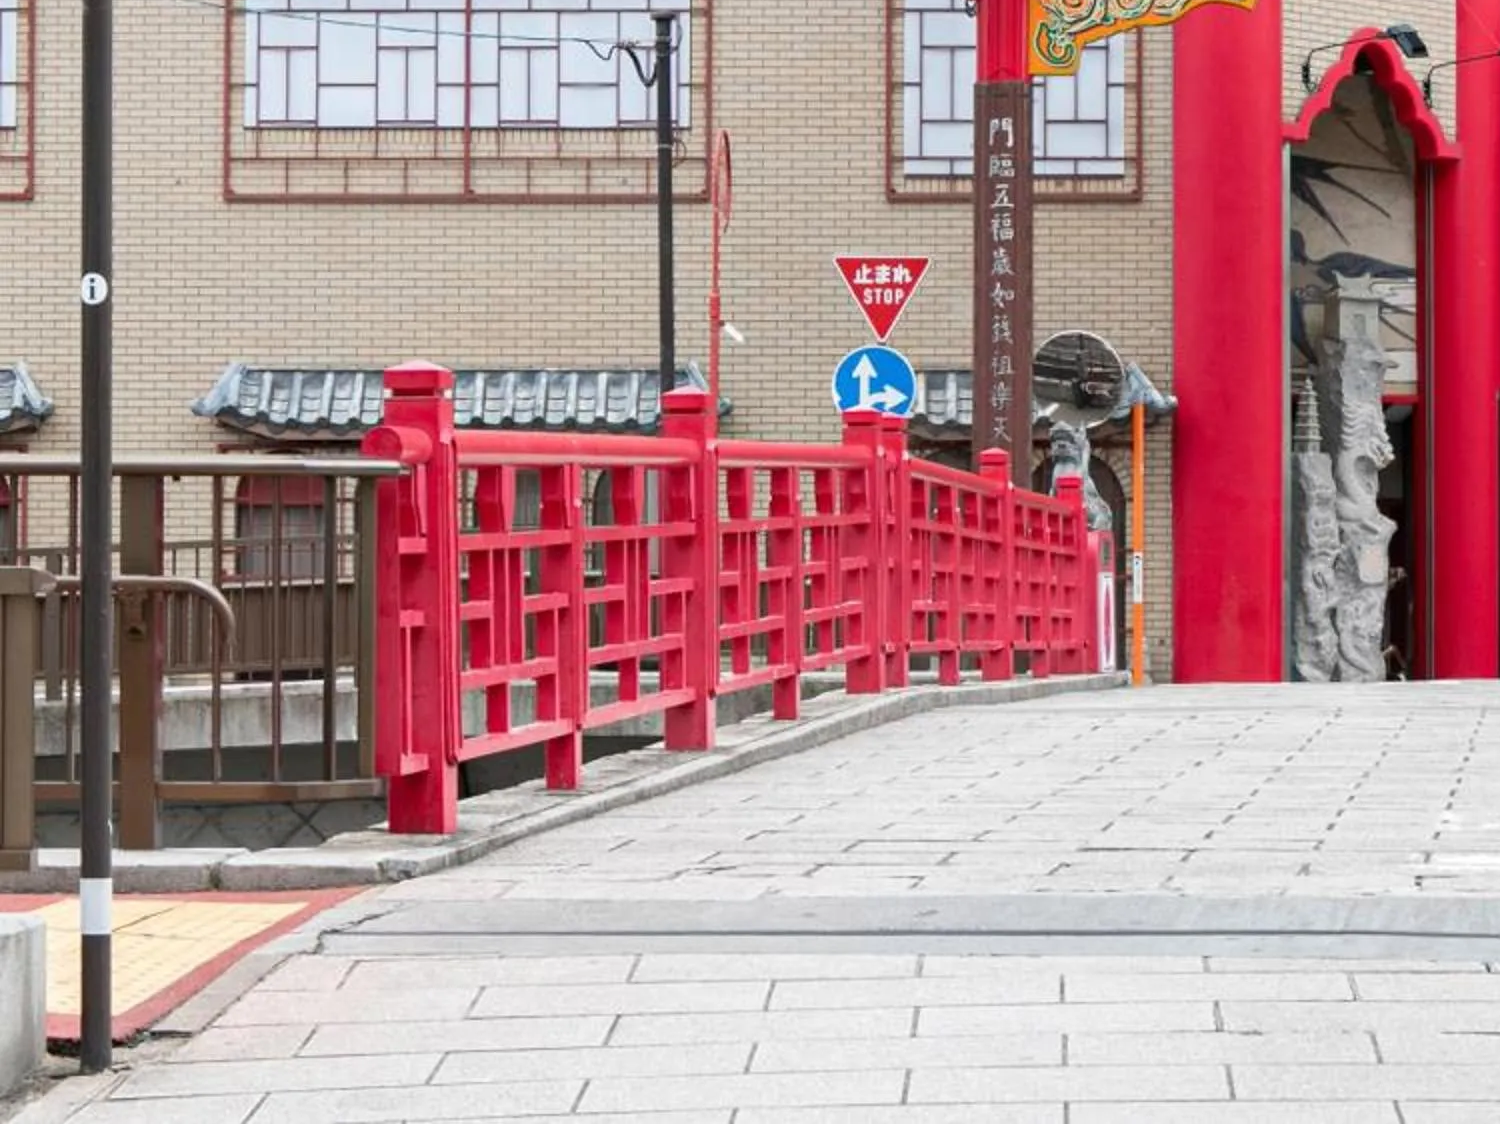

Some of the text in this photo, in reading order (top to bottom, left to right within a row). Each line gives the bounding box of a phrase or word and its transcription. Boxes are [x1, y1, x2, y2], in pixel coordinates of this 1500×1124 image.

[853, 263, 912, 284] 止まれ
[863, 287, 904, 305] STOP
